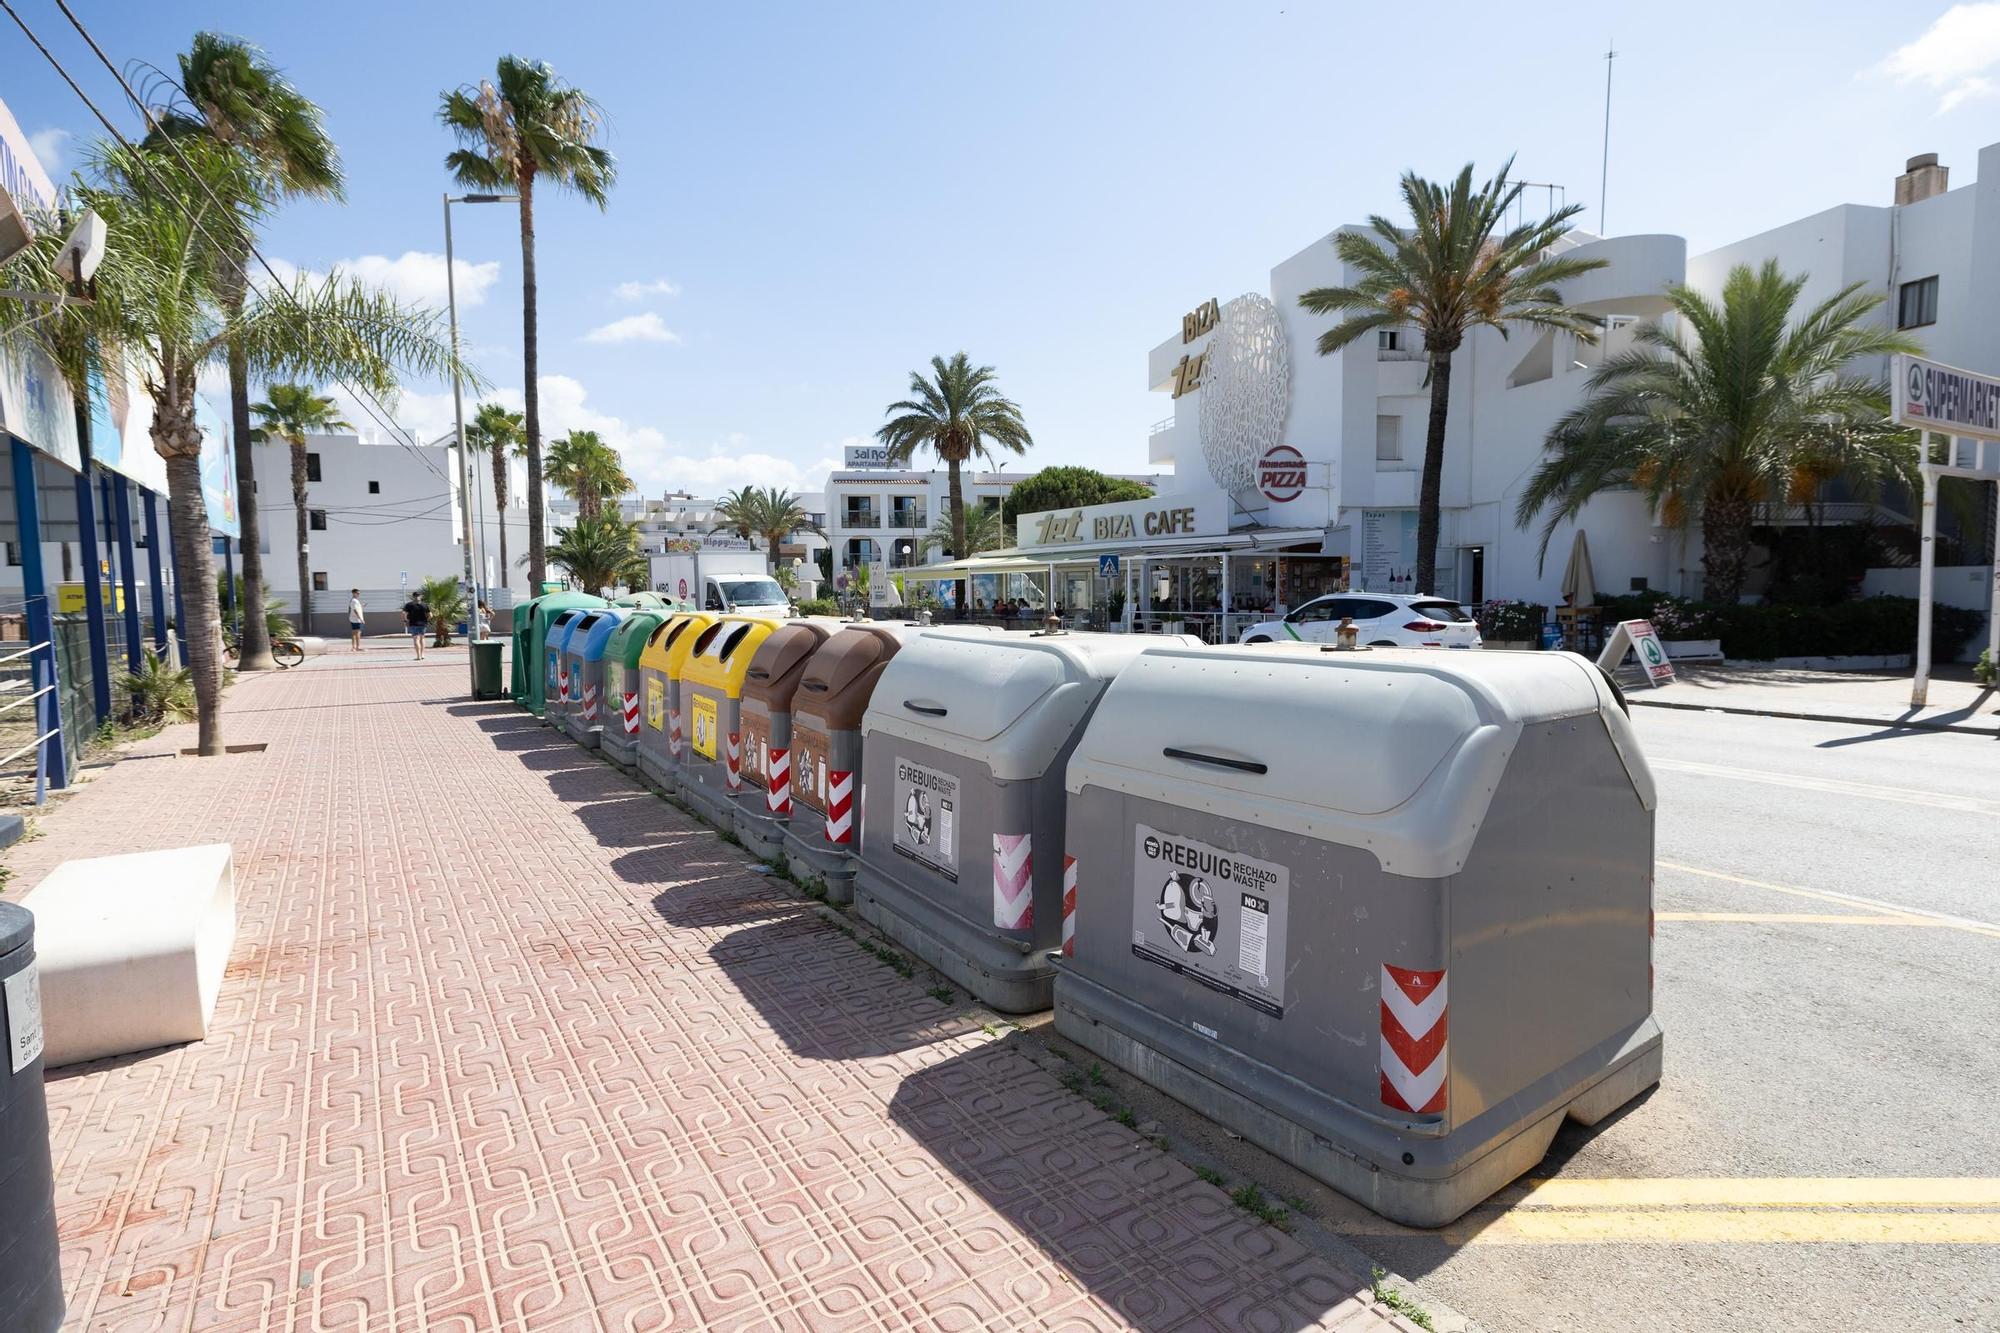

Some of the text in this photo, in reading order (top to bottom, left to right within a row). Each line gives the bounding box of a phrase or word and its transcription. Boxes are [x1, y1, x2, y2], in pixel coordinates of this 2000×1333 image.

[1183, 298, 1220, 344] IBIZA
[1925, 367, 2000, 429] SUPERMARKET
[854, 449, 870, 459] Sal
[1259, 460, 1307, 468] Homemade
[1260, 471, 1306, 488] PIZZA
[1093, 514, 1136, 540] IBIZA
[1144, 507, 1195, 536] CAFE
[907, 766, 938, 791] REBUIG
[1163, 840, 1277, 884] REBUIG RECHAZO
[1233, 871, 1266, 892] WASTE
[1244, 895, 1257, 908] NO
